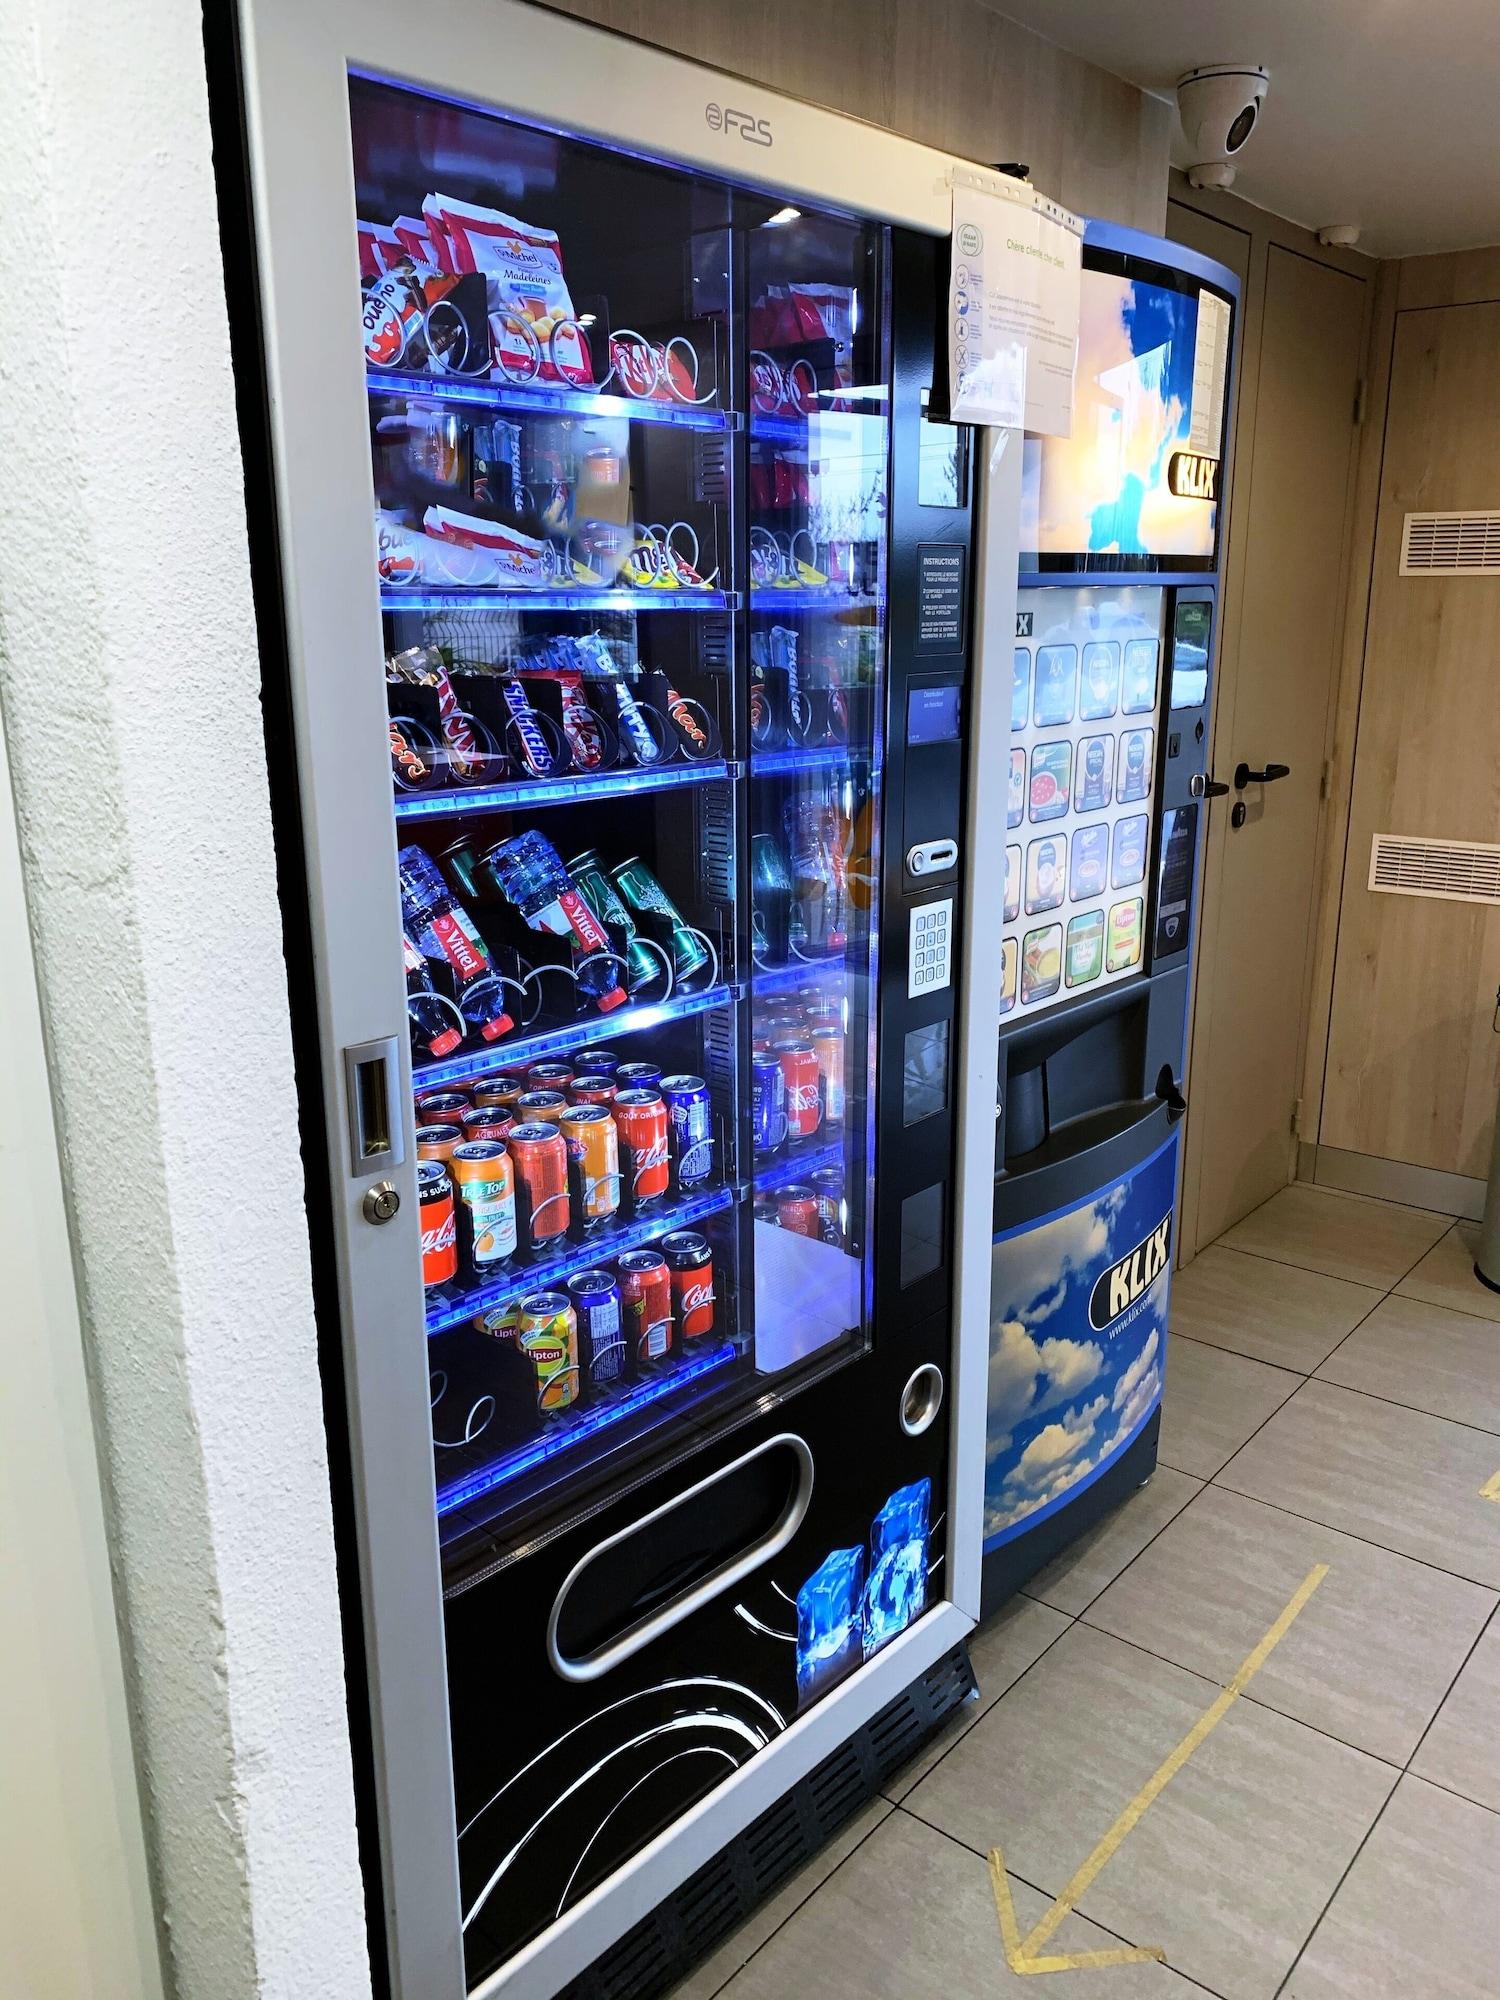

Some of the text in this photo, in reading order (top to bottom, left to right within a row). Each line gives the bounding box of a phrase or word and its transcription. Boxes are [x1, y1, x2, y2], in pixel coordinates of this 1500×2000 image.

[504, 250, 538, 263] Michel
[504, 269, 552, 285] Madeleines
[1177, 454, 1217, 499] KLIX
[923, 558, 960, 567] INSTRUCTIONS
[504, 684, 552, 771] SNICKERS
[572, 905, 603, 946] Vittel
[446, 928, 478, 972] Vittel
[1110, 1218, 1169, 1318] KLIX
[528, 1349, 560, 1361] Lipton
